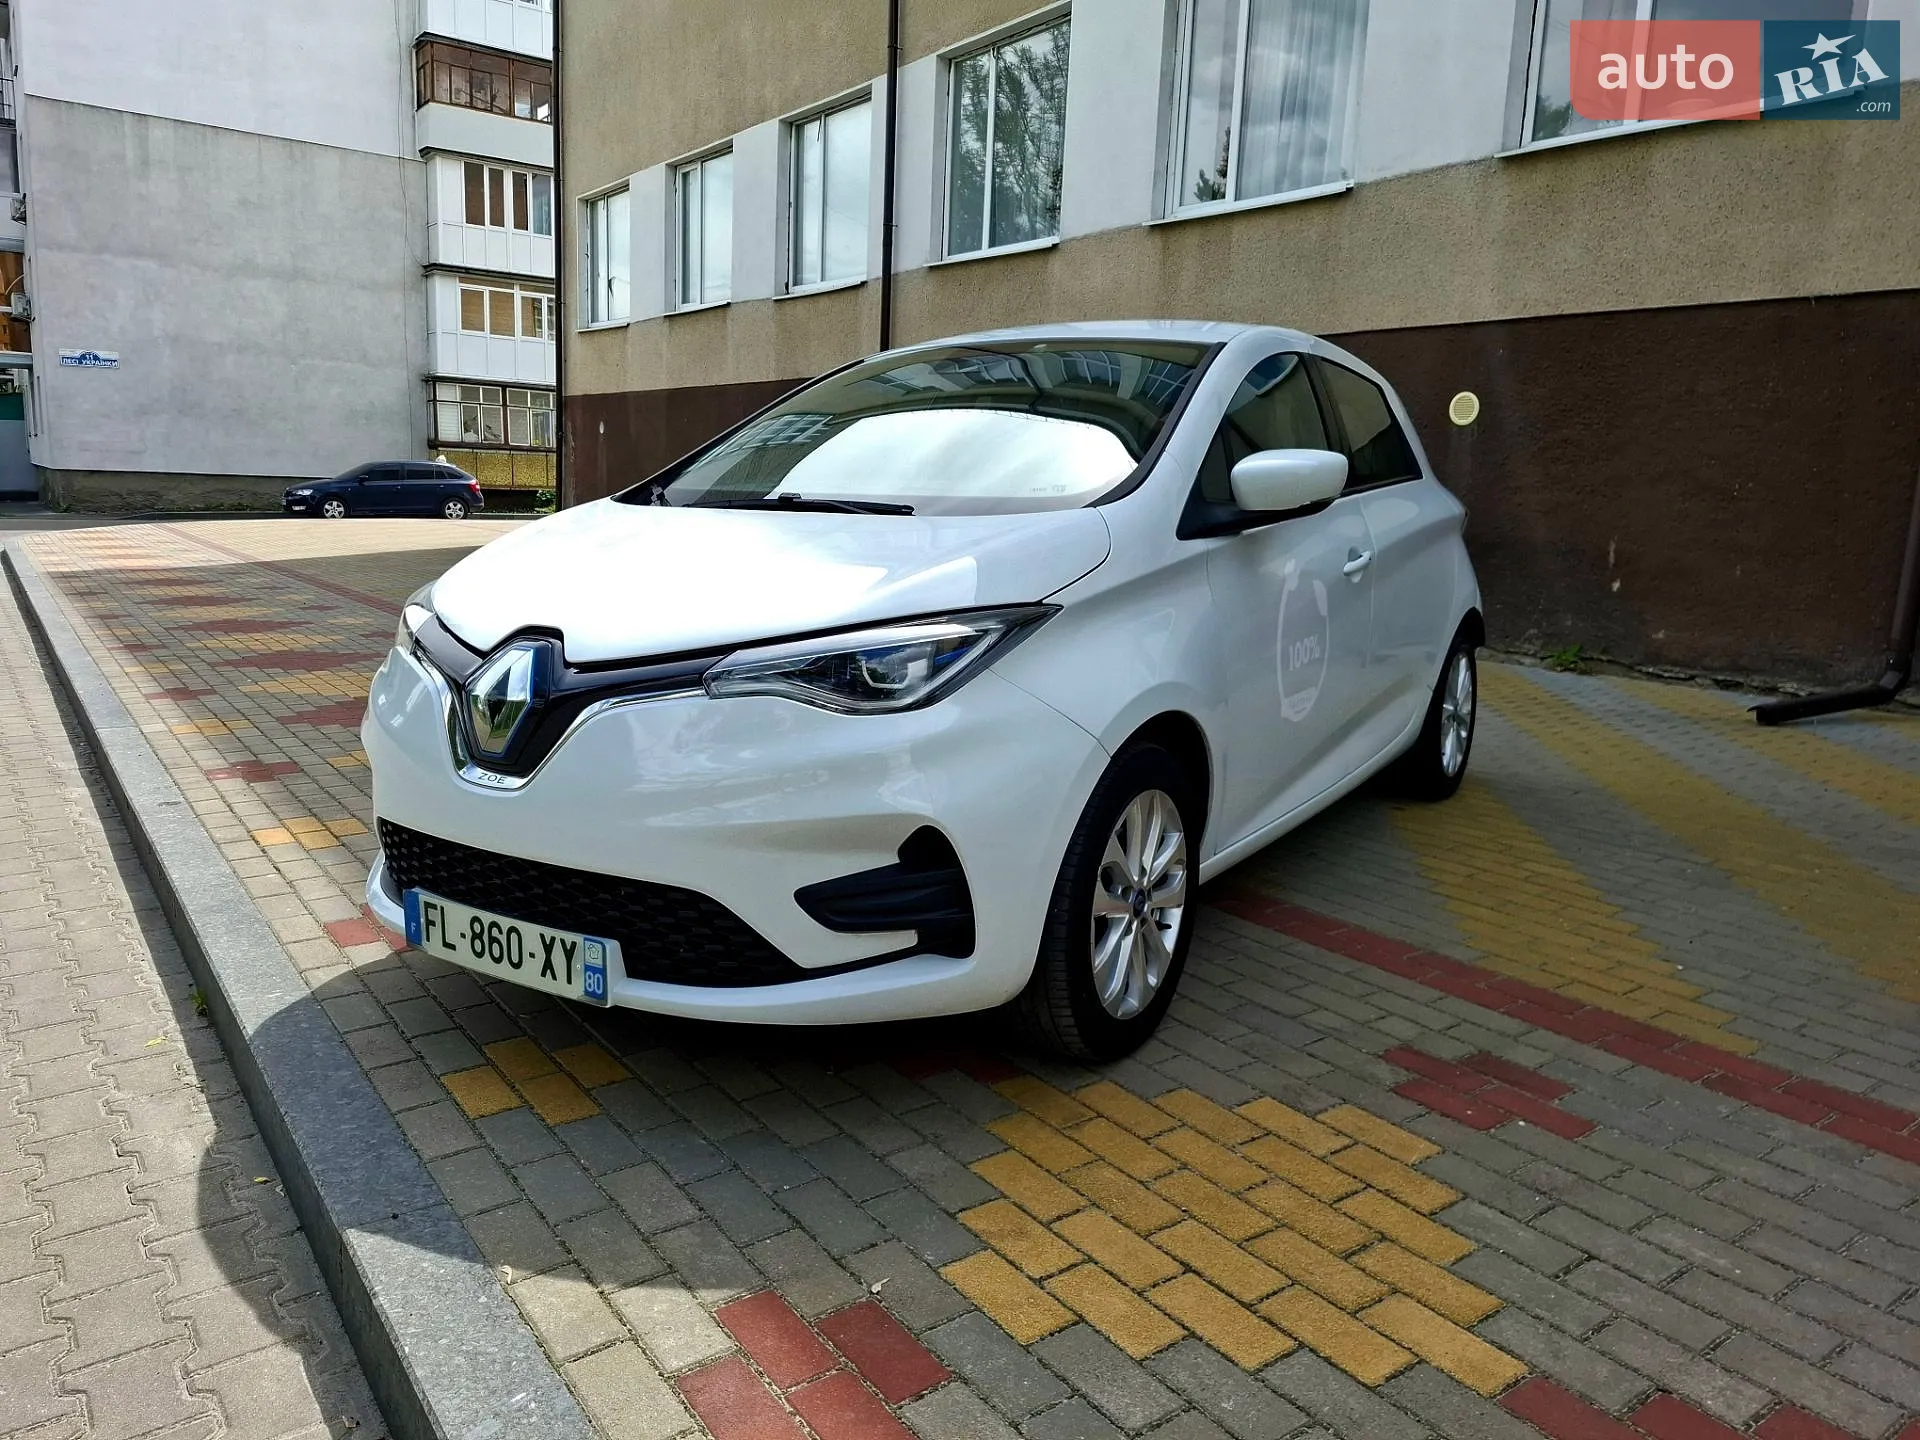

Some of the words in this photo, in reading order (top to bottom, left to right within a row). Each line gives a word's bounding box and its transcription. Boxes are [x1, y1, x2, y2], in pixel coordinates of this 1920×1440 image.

[1288, 634, 1320, 671] 100%
[478, 772, 507, 784] ZOE
[423, 900, 577, 985] FL-860-XY
[586, 971, 603, 994] 80
